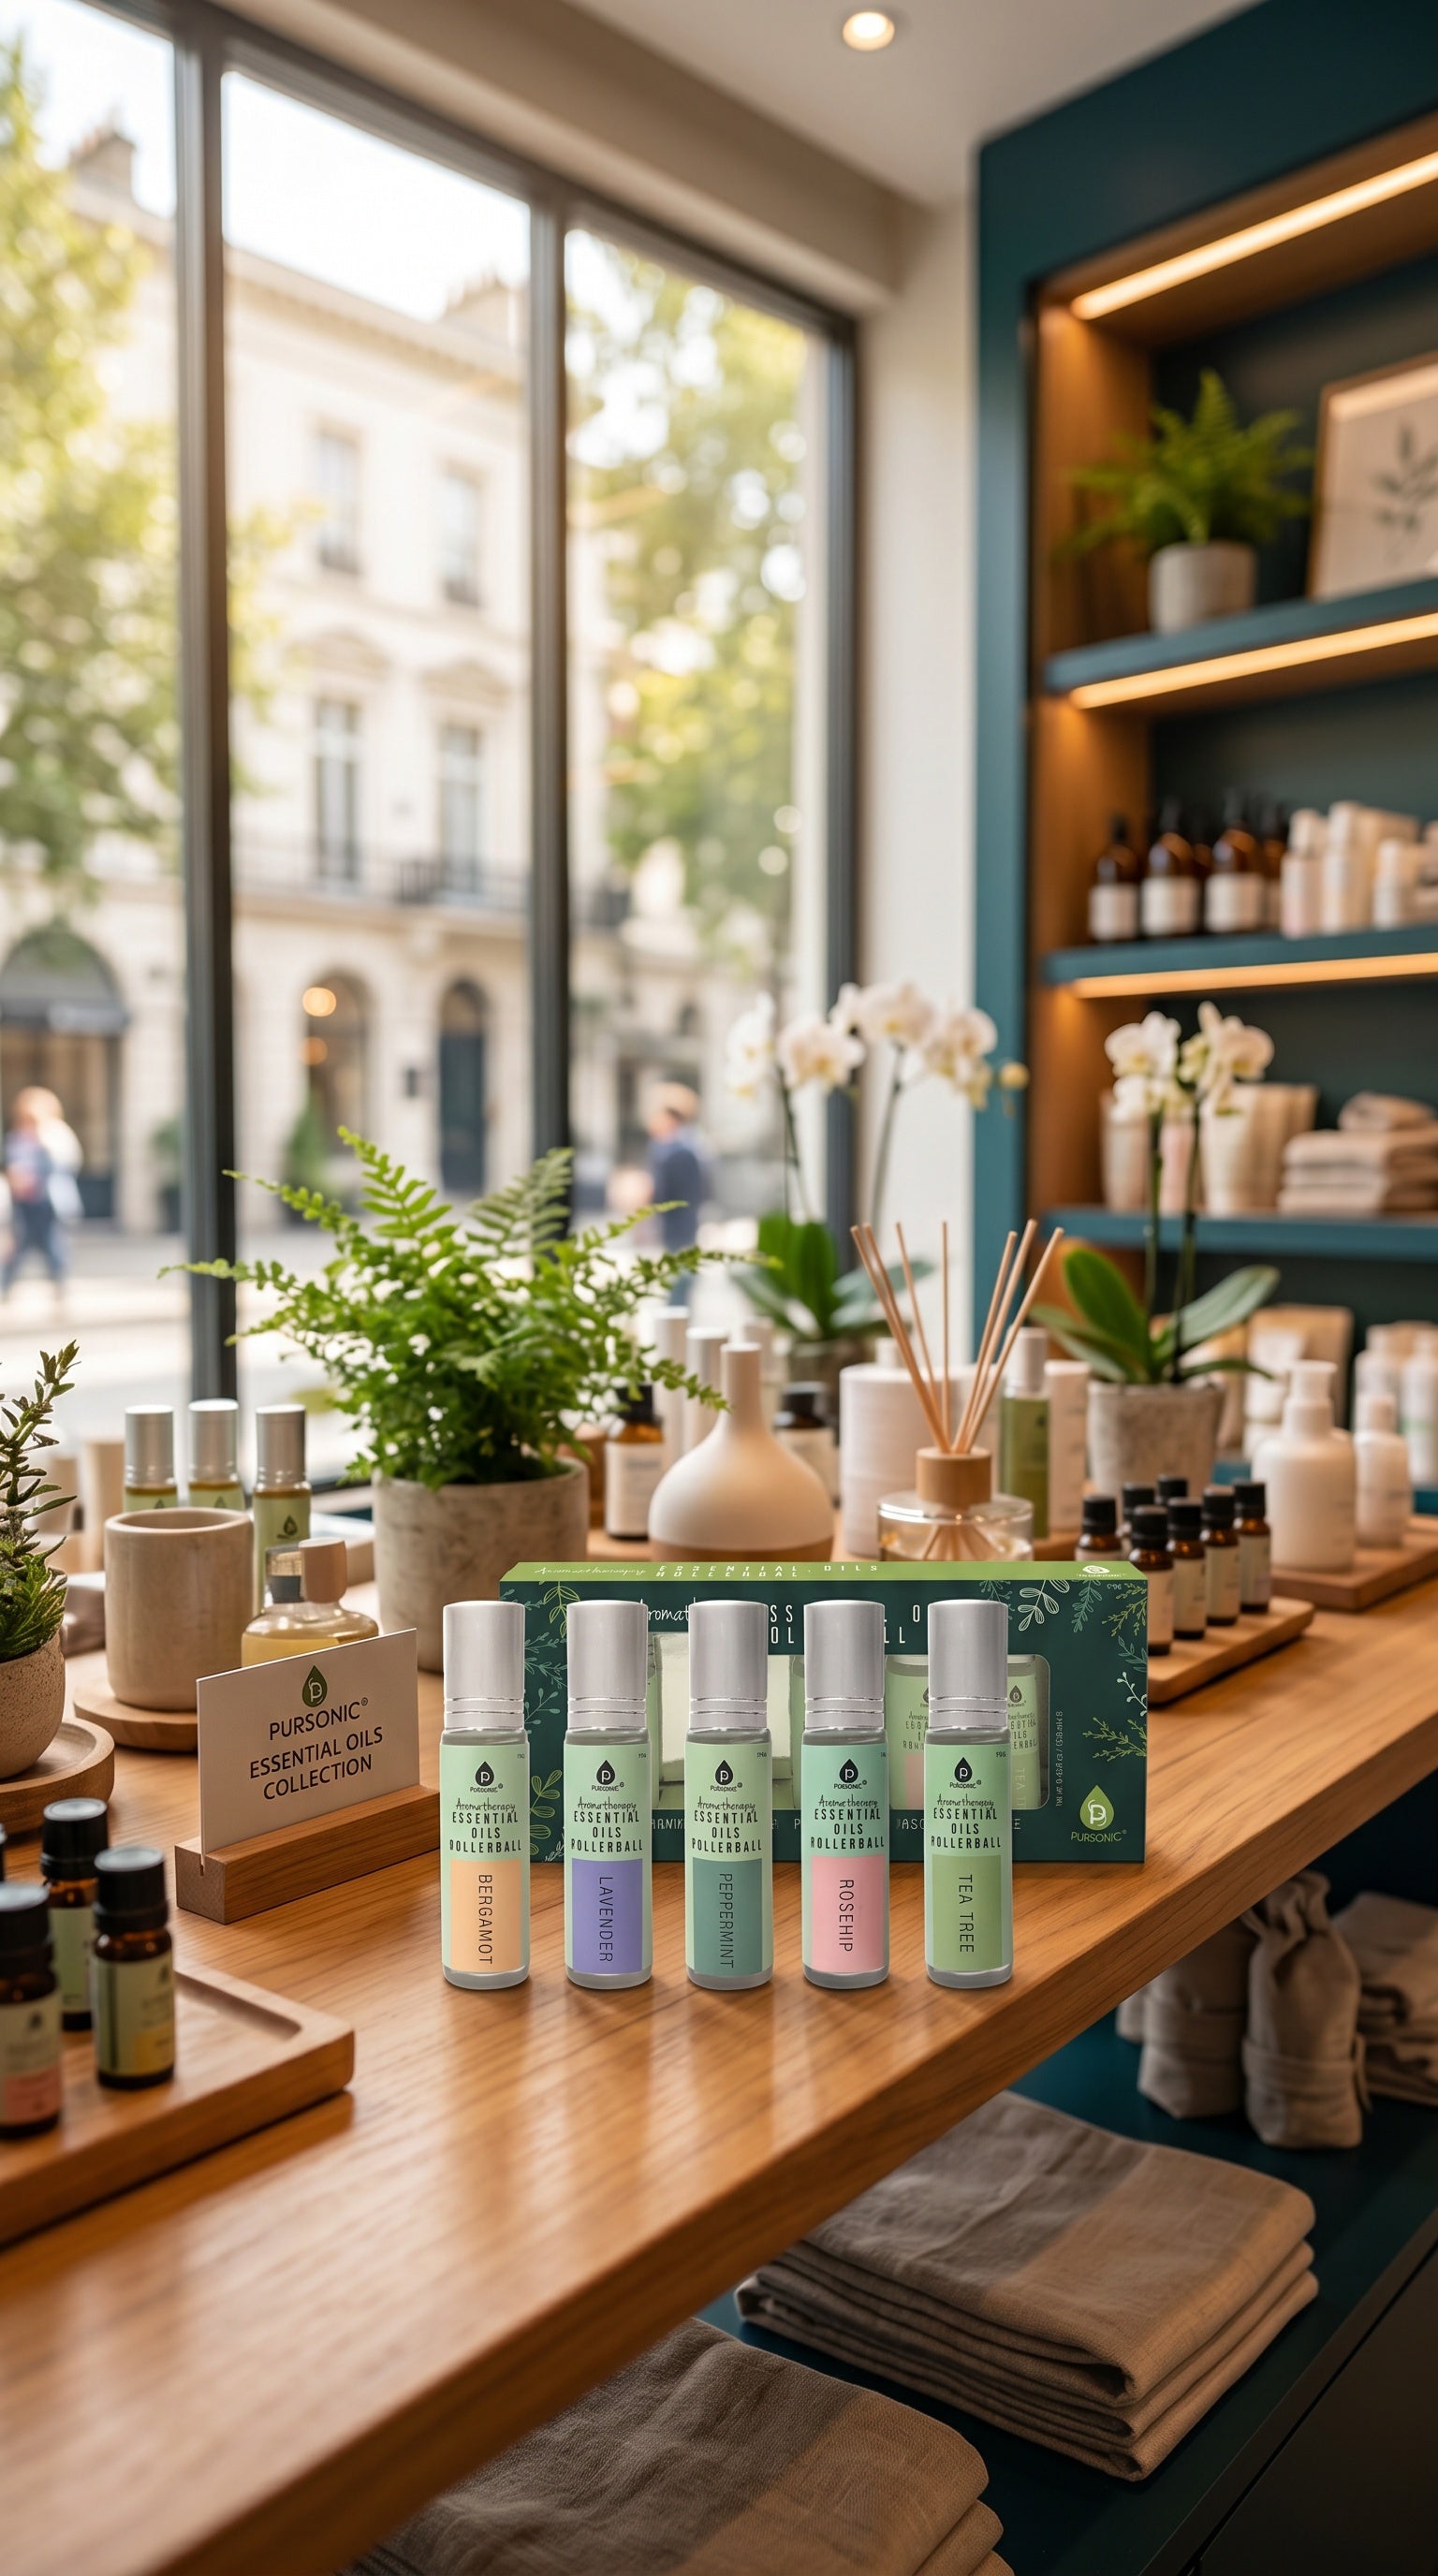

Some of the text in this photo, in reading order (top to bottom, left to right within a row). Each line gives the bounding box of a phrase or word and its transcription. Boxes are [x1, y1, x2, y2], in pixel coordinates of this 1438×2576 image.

[250, 1726, 383, 1779] ESSENTIAL OILS
[264, 1754, 372, 1800] COLLECTION
[452, 1812, 519, 1824] ESSENTIAL
[574, 1810, 640, 1823] ESSENTIAL
[694, 1809, 758, 1824] ESSENTIAL
[814, 1808, 881, 1821] ESSENTIAL
[933, 1808, 998, 1821] ESSENTIAL
[472, 1827, 501, 1839] OILS
[593, 1826, 622, 1838] OILS
[712, 1826, 741, 1839] OILS
[834, 1823, 863, 1835] OILS
[951, 1823, 979, 1835] OILS
[811, 1837, 885, 1850] ROLLERBALL
[931, 1836, 1001, 1849] ROLLERBALL
[477, 1874, 493, 1965] BERGAMOT
[599, 1877, 614, 1962] LAVENDER
[839, 1880, 854, 1952] ROSEHIP
[959, 1874, 975, 1953] TEA TREE
[719, 1873, 734, 1969] PEPPERMINT
